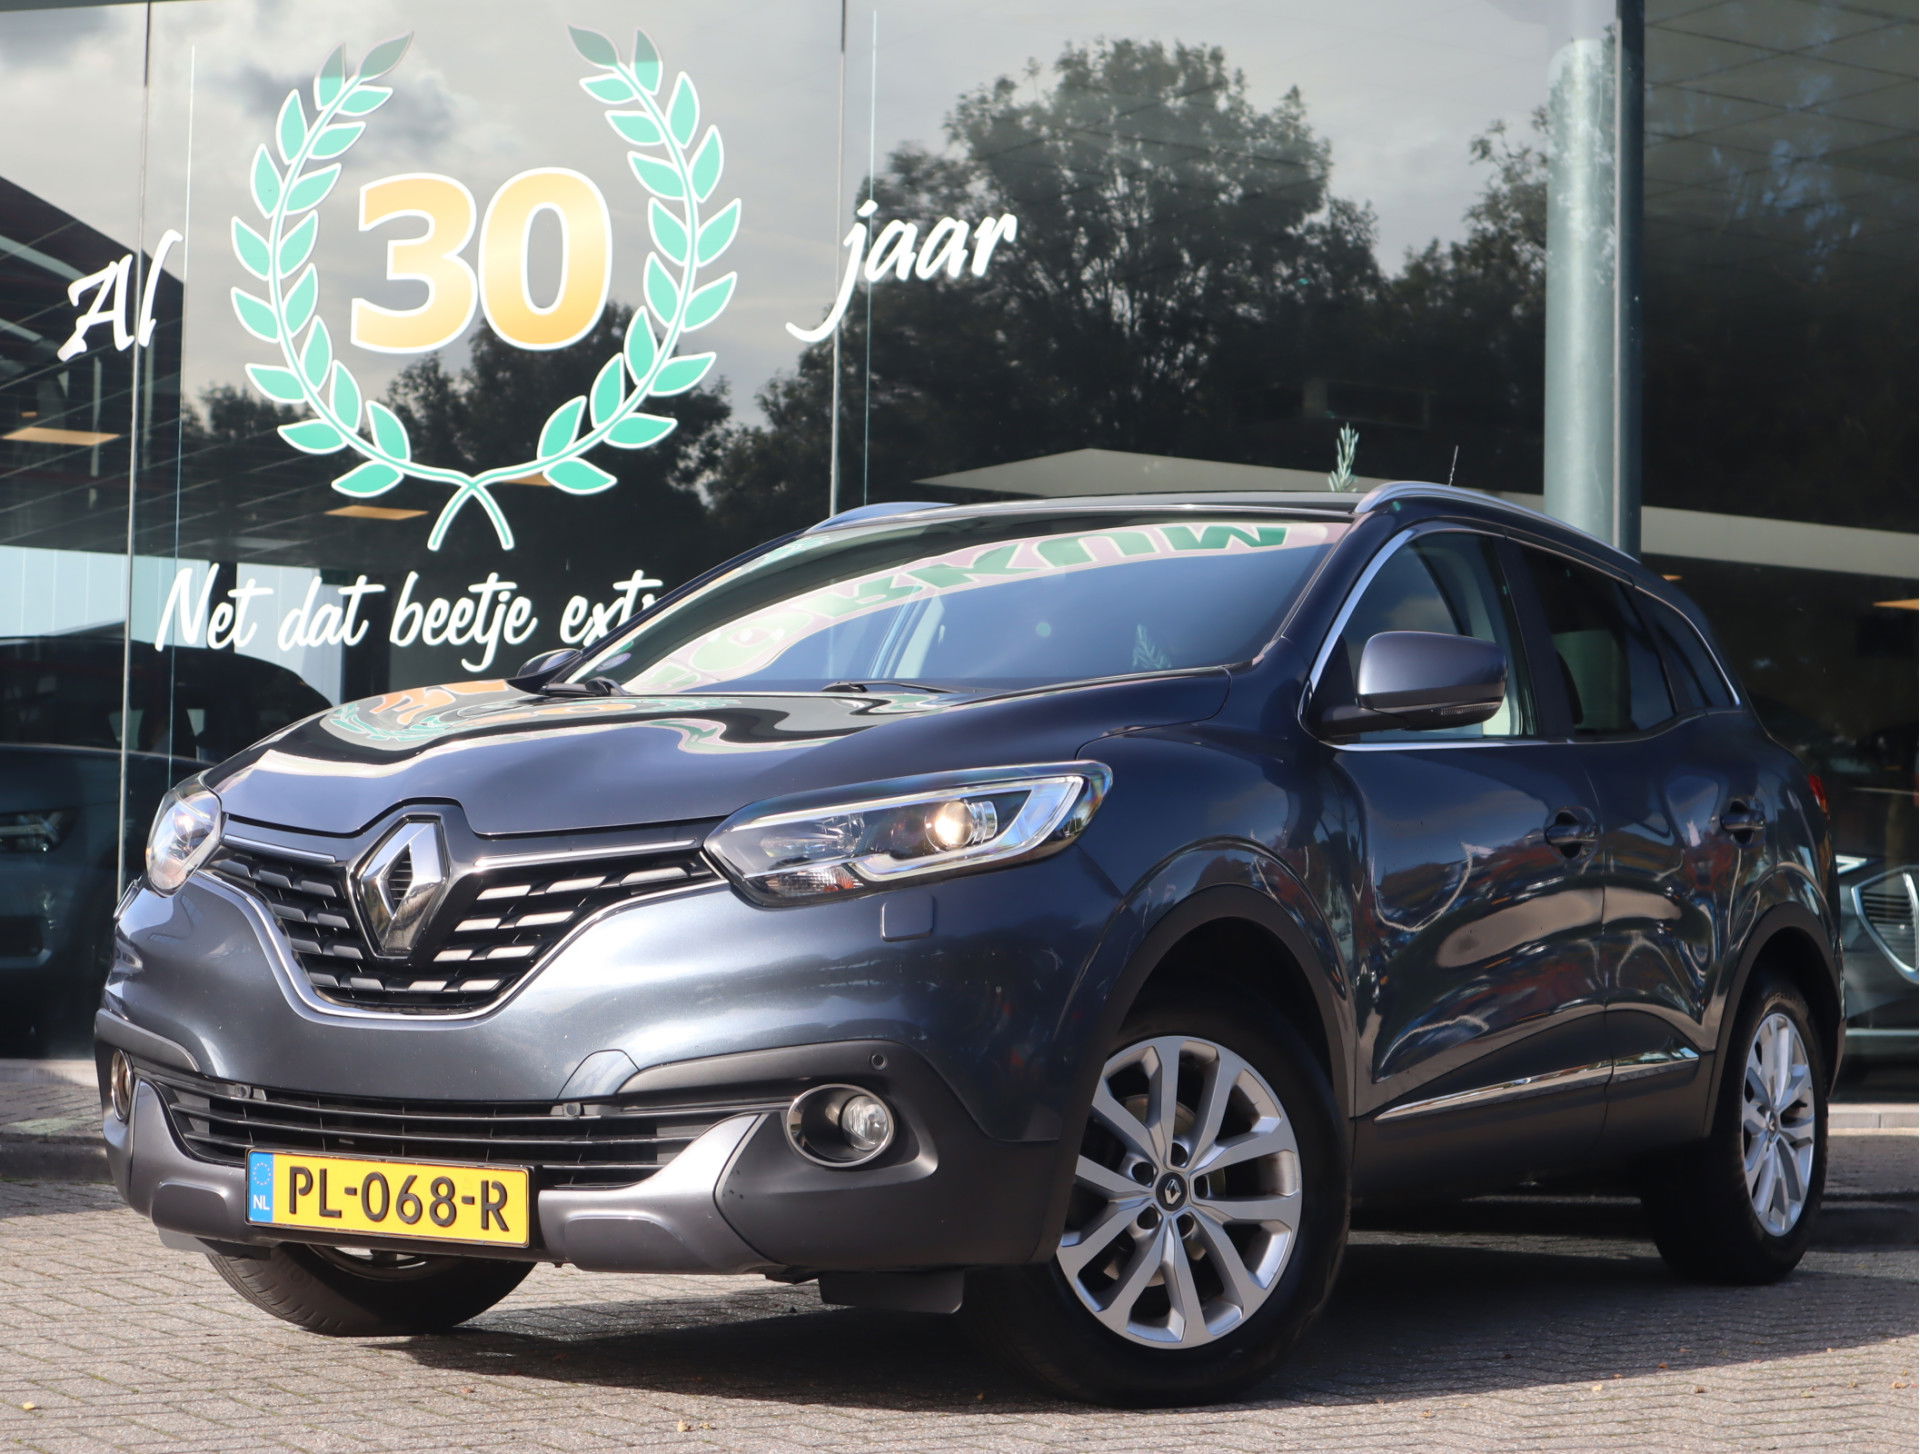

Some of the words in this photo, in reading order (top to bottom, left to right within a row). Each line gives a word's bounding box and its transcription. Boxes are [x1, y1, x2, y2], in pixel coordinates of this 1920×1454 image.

[57, 229, 183, 362] Al
[350, 165, 613, 353] 30
[785, 199, 1018, 342] jaar
[155, 563, 274, 652] Net
[278, 576, 386, 651] dat
[389, 571, 538, 672] beetje
[253, 1194, 271, 1211] NL
[288, 1165, 510, 1232] PL-068-R
